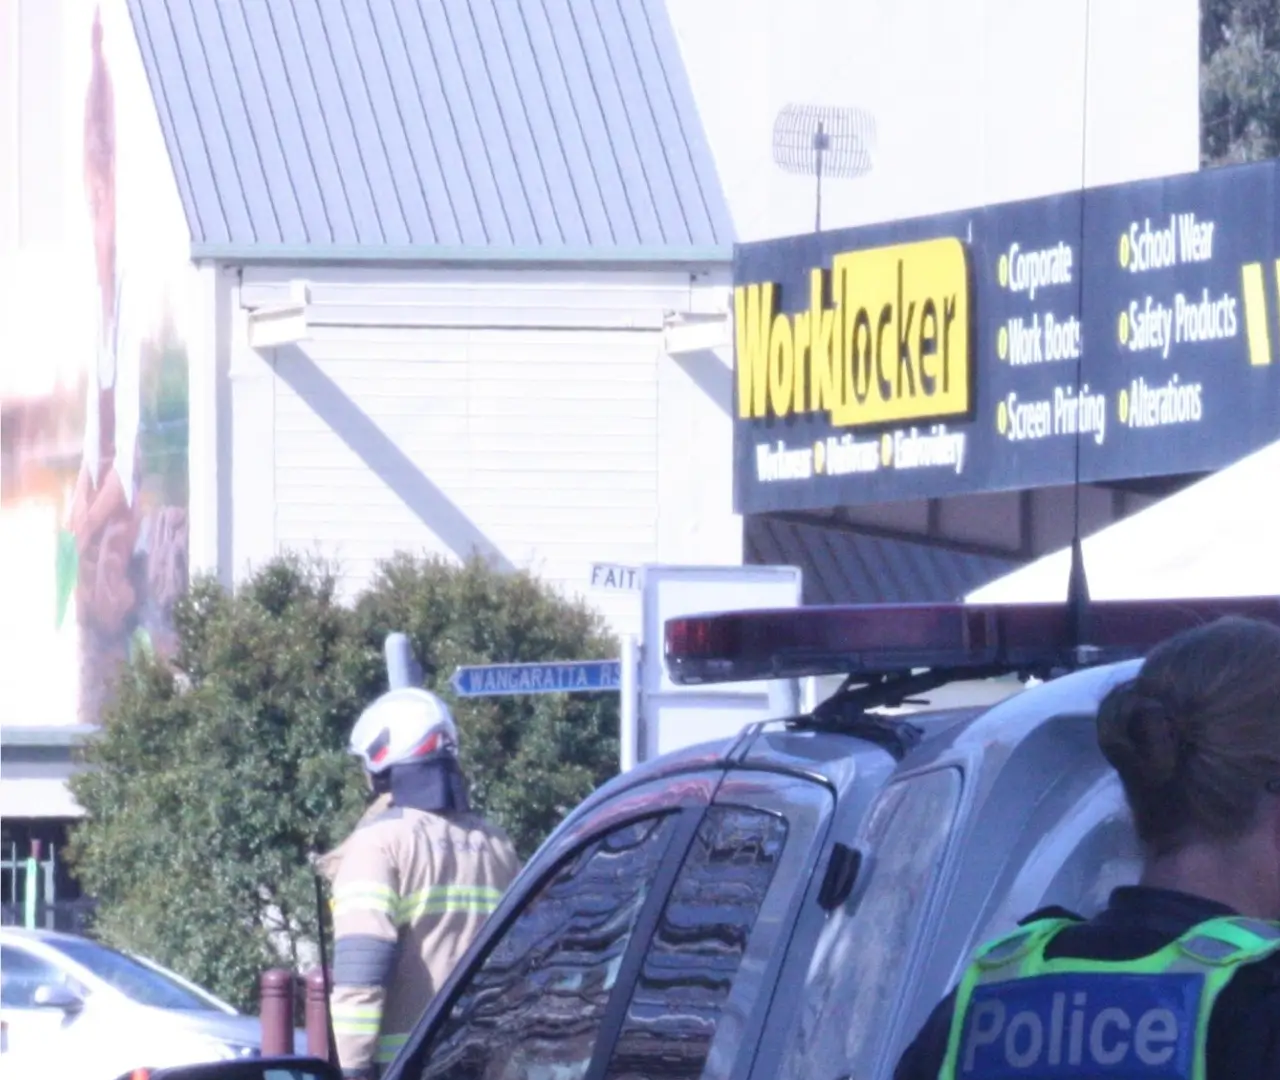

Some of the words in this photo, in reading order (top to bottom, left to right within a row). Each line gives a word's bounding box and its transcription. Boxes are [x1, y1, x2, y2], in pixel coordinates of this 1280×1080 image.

[1008, 240, 1073, 300] Corporate
[1129, 213, 1176, 273] School
[1178, 212, 1215, 262] Wear
[734, 258, 957, 419] Worklocker
[1008, 313, 1042, 366] Work
[1128, 295, 1173, 359] Safety
[1174, 287, 1238, 343] Products
[1007, 392, 1051, 441] Screen
[1054, 383, 1106, 445] Printing
[1128, 373, 1203, 428] Alterations
[591, 566, 641, 590] FAIT
[469, 665, 588, 692] WANGARATTA
[961, 991, 1179, 1073] Police
